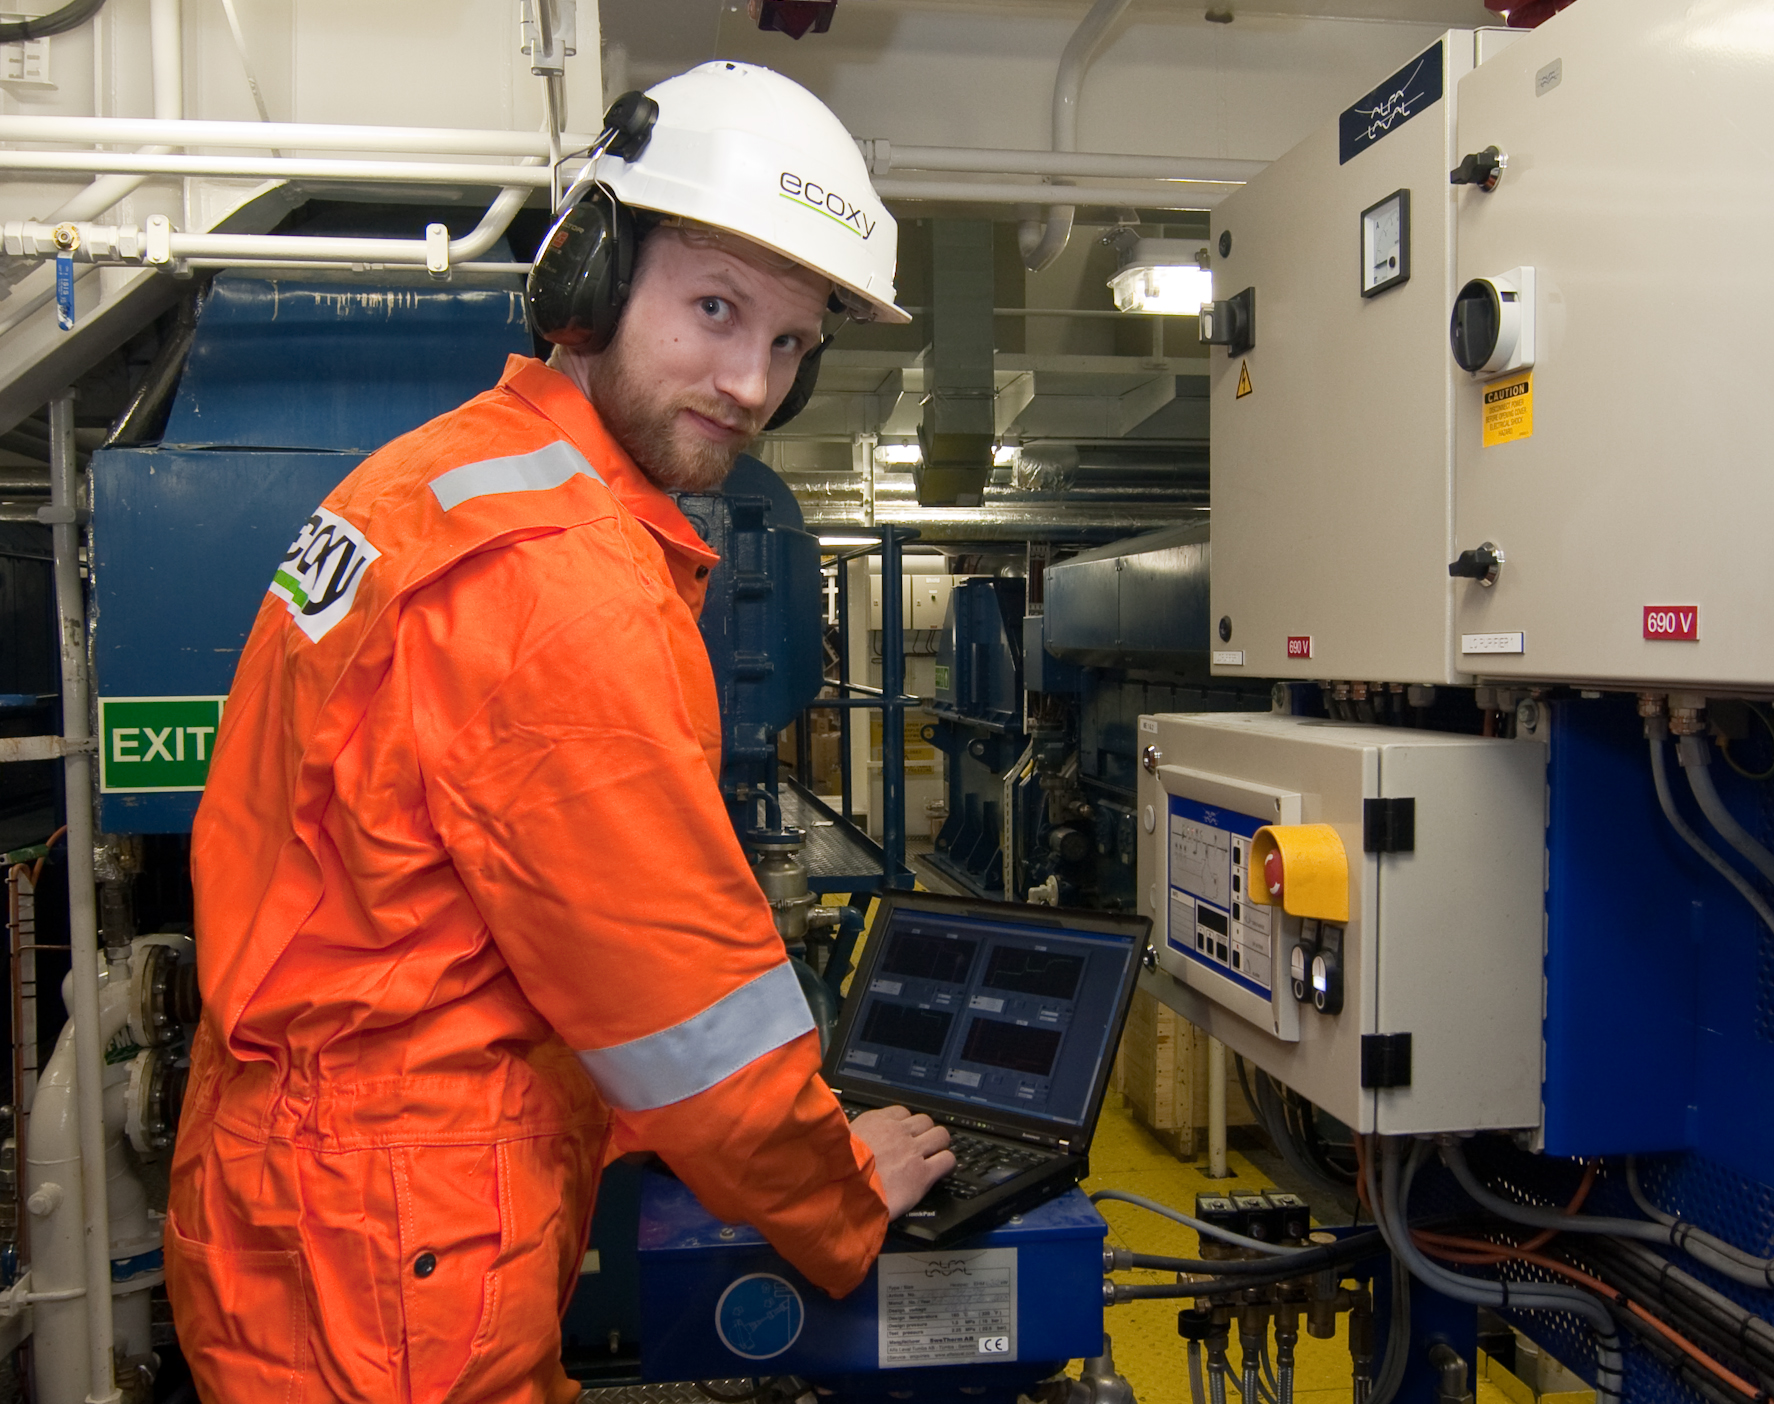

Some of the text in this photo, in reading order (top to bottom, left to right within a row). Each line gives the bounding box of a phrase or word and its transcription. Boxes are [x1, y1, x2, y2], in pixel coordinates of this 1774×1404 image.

[780, 172, 876, 240] ecoxy
[1488, 384, 1525, 403] CAUTION
[283, 515, 366, 615] coxy
[1647, 612, 1693, 633] 690 V
[1289, 640, 1309, 654] 690 V
[112, 727, 215, 762] EXIT
[925, 1268, 972, 1278] LAVAL
[928, 1260, 965, 1269] ALFA
[984, 1338, 1003, 1352] CE
